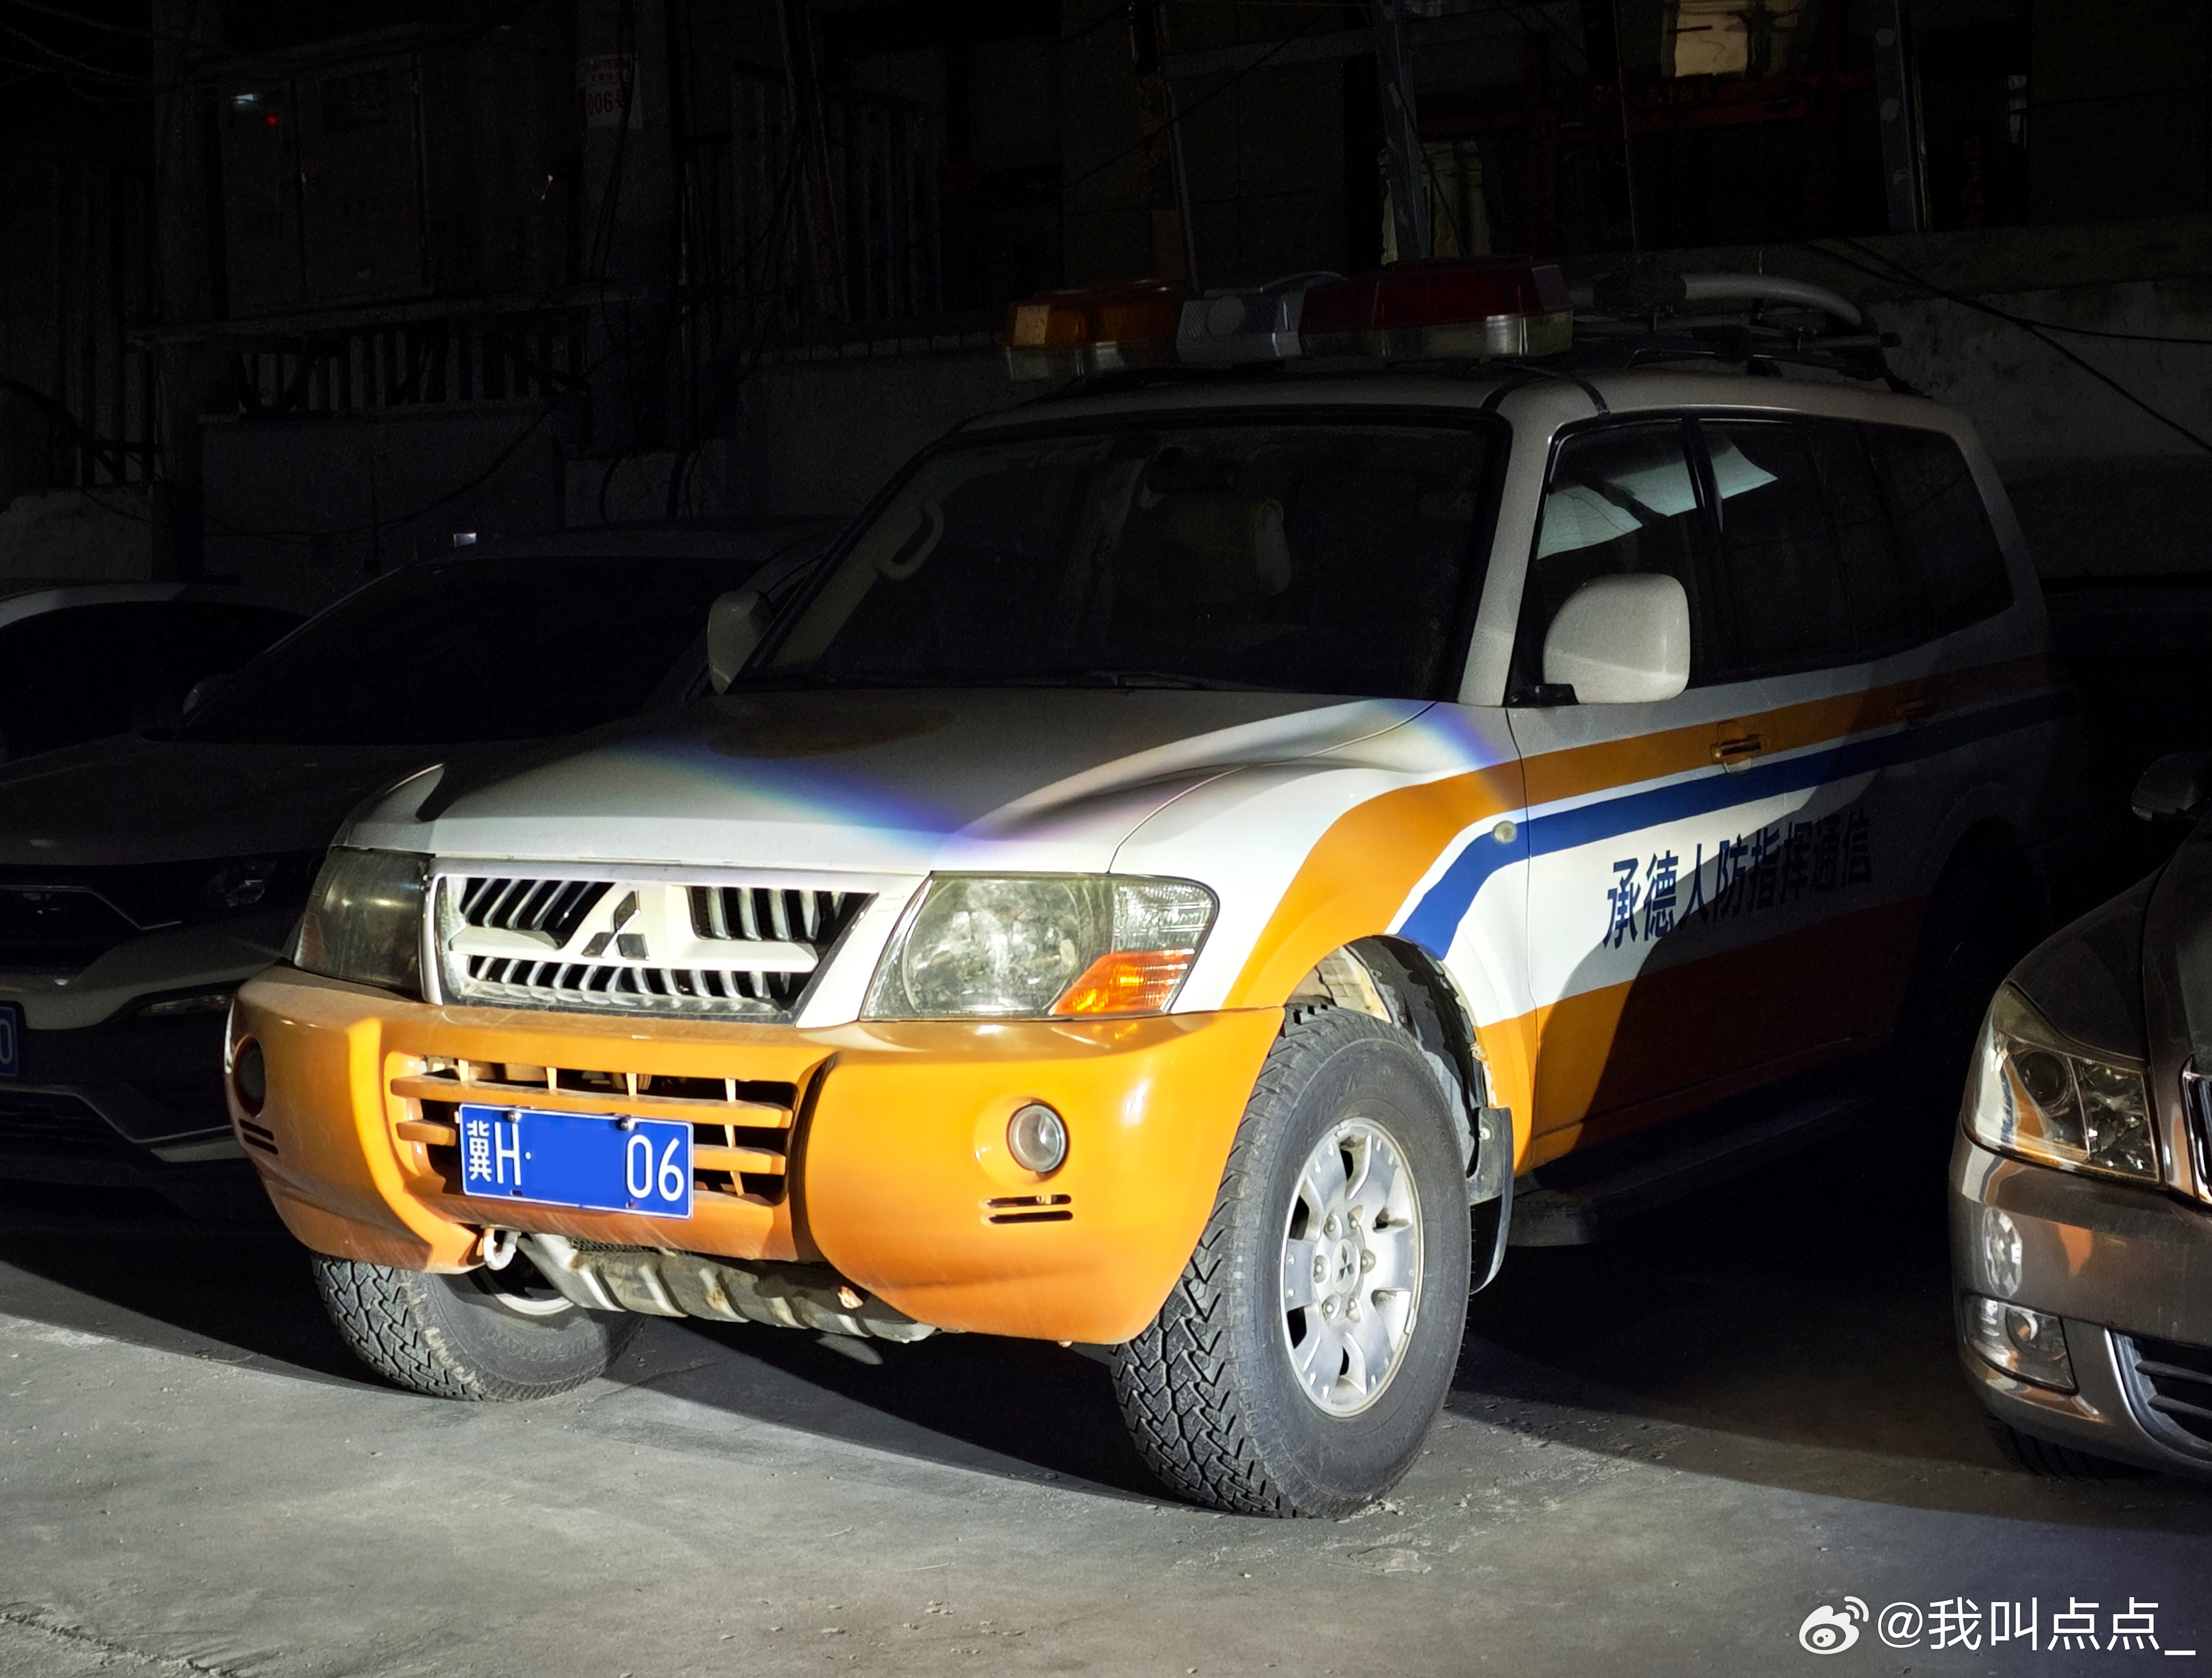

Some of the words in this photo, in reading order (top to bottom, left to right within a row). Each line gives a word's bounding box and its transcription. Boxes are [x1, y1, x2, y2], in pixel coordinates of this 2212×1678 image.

[1603, 807, 1871, 949] 承德人防指挥通信
